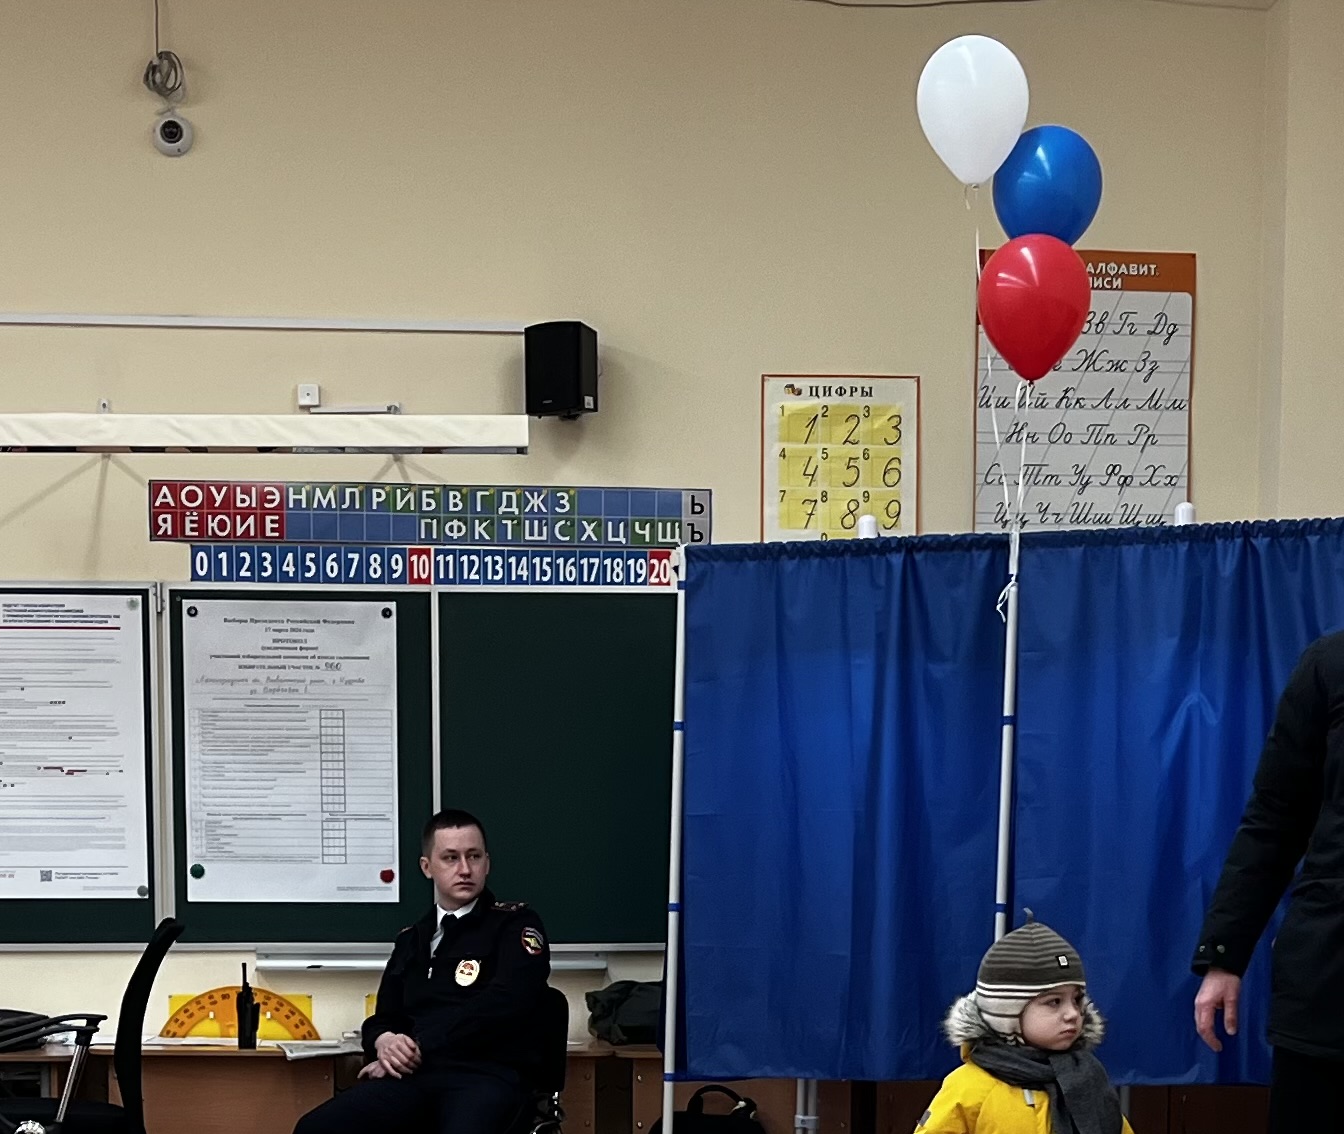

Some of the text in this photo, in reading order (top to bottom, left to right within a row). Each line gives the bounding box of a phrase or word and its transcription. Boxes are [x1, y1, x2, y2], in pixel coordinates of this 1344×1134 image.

[1113, 312, 1138, 334] Гг
[1146, 312, 1179, 345] Дд
[1072, 349, 1128, 372] Жж
[1134, 351, 1159, 383] Зз
[809, 385, 873, 398] ЦИФРЫ
[1055, 387, 1086, 409] Кк
[1091, 388, 1131, 409] Лл
[1136, 388, 1187, 410] Мм
[780, 405, 901, 445] 1 1 2 2 3 3
[1048, 423, 1073, 444] Оо
[1080, 424, 1117, 445] Пп
[1128, 424, 1158, 453] Рр
[779, 448, 901, 487] 4 4 5 5 6 6
[1069, 464, 1093, 495] Уу
[1099, 464, 1133, 495] Фф
[1139, 465, 1179, 486] Хх
[155, 486, 704, 514] А О У Ы Э Н М Л Р Й Б В Г Д Ж З Ь
[779, 490, 901, 530] 7 7 8 8 9 9
[1036, 502, 1063, 523] Чч
[1069, 502, 1113, 524] Шш
[157, 512, 703, 545] Я Ё Ю И Е П Ф К Т Ш С Х Ц Ч Щ Ъ
[195, 551, 670, 583] 0 1 2 3 4 5 6 7 8 9 10 11 12 13 14 15 16 17 18 19 20
